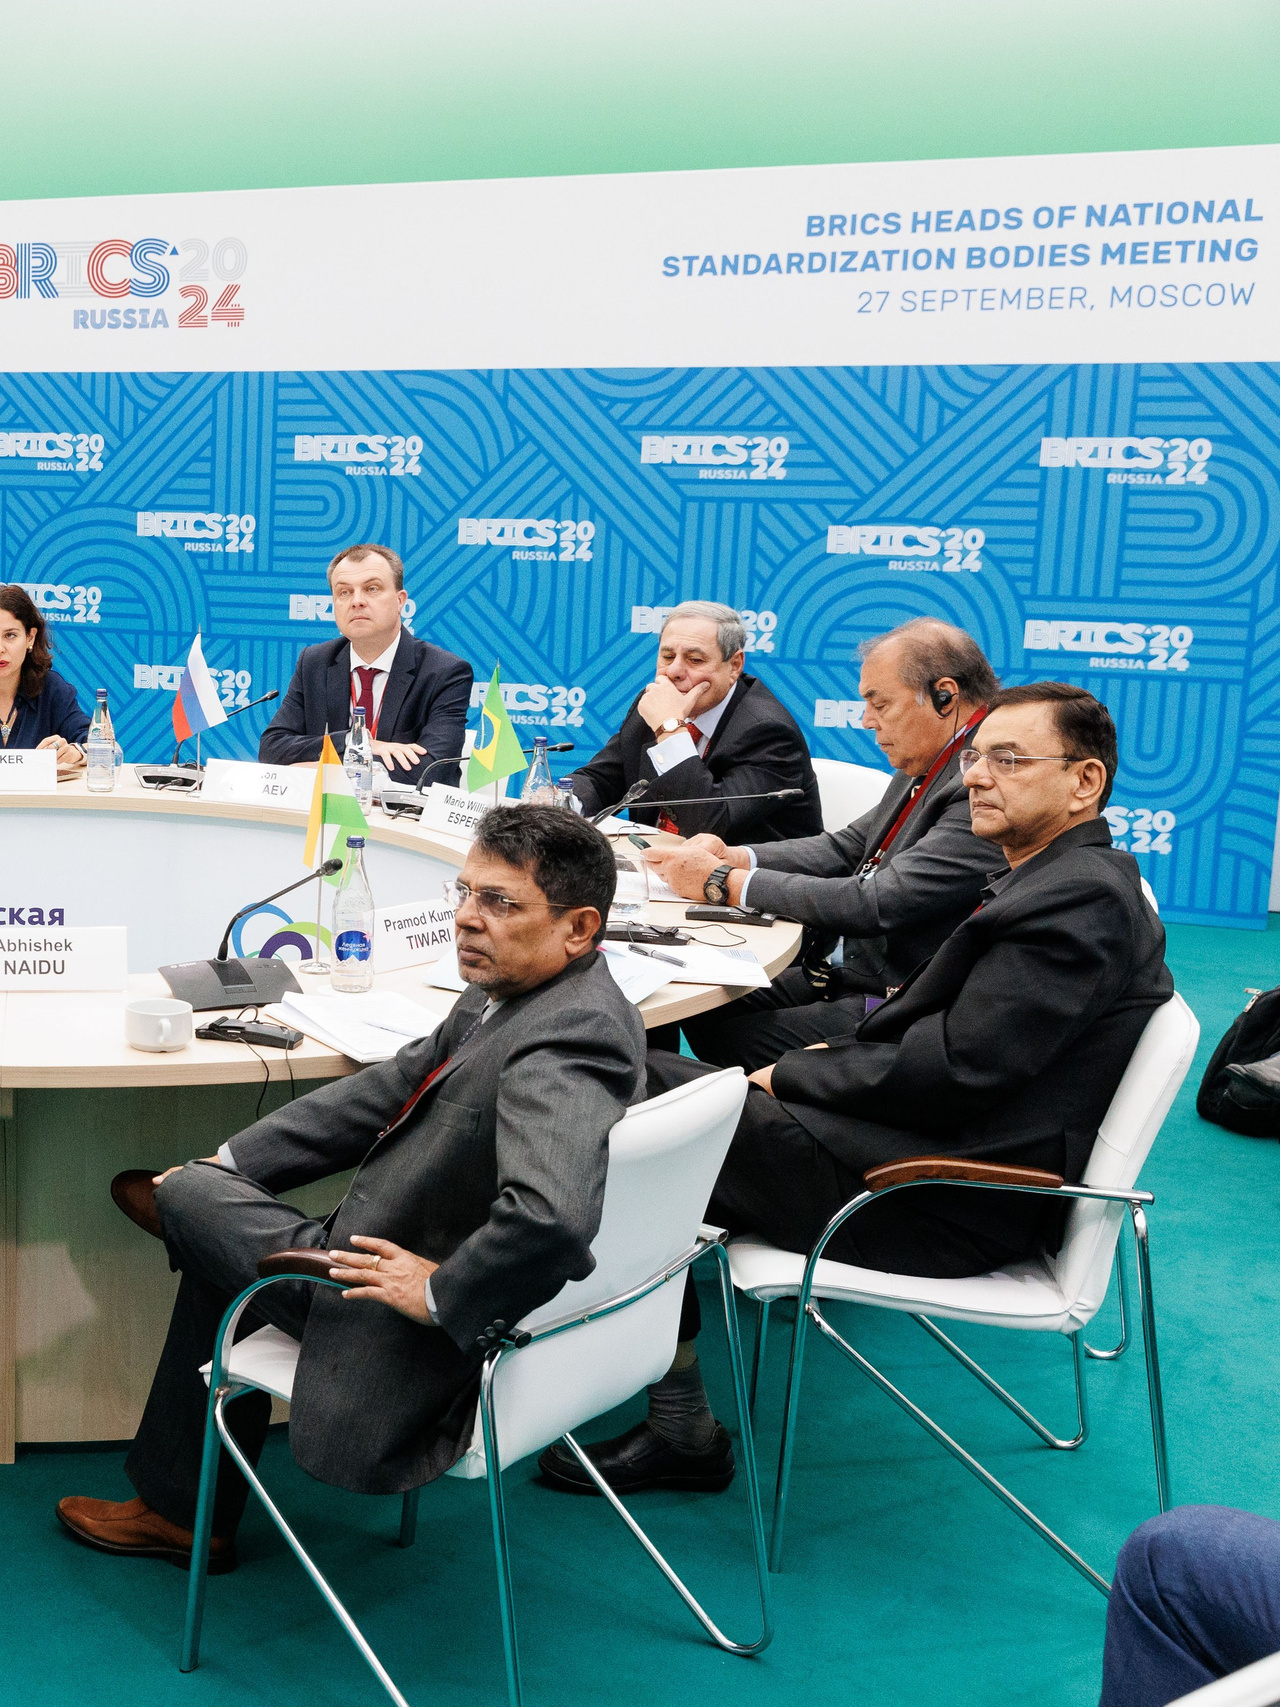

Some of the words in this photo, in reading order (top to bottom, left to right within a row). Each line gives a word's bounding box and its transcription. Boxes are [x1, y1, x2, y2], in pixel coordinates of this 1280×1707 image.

[806, 212, 901, 237] BRICS
[911, 207, 1023, 234] HEADS
[1033, 206, 1076, 229] OF
[1085, 198, 1263, 228] NATIONAL
[662, 248, 956, 277] STANDARDIZATION
[966, 243, 1090, 269] BODIES
[1101, 238, 1258, 266] MEETING
[73, 309, 169, 329] RUSSIA
[178, 284, 245, 329] 24
[857, 291, 890, 313] 27
[901, 287, 1094, 312] SEPTEMBER,
[1110, 282, 1255, 308] MOSCOW
[75, 434, 105, 452] 20
[294, 435, 388, 462] BRICS
[390, 435, 423, 456] 20
[640, 435, 748, 465] BRICS
[751, 436, 790, 459] 20
[1039, 437, 1165, 469] BRICS
[1167, 437, 1212, 462] 20
[37, 462, 74, 471] RUSSIA
[75, 453, 103, 471] 24
[345, 466, 387, 476] RUSSIA
[389, 456, 421, 476] 24
[699, 469, 747, 480] RUSSIA
[749, 458, 787, 480] 24
[1106, 473, 1162, 484] RUSSIA
[1165, 461, 1209, 485] 24
[137, 511, 222, 539] BRICS
[226, 514, 256, 534] 20
[458, 518, 557, 547] BRICS
[559, 520, 596, 541] 20
[184, 542, 223, 552] RUSSIA
[225, 533, 255, 553] 24
[512, 550, 557, 561] RUSSIA
[558, 541, 593, 562] 24
[826, 525, 941, 557] BRICS
[943, 527, 986, 551] 20
[888, 560, 940, 572] RUSSIA
[942, 550, 983, 572] 24
[74, 586, 102, 605] 20
[41, 612, 72, 622] USSIA
[73, 605, 101, 623] 24
[1023, 619, 1146, 654] BRICS
[1149, 624, 1194, 649] 20
[1089, 657, 1145, 670] RUSSIA
[1147, 648, 1190, 671] 24
[221, 669, 251, 689] 20
[551, 686, 586, 708] 20
[550, 706, 584, 727] 24
[444, 794, 466, 809] Mario
[1132, 808, 1176, 833] 20
[1131, 830, 1172, 855] 24
[384, 912, 427, 932] Pramod
[406, 928, 452, 950] TIWARI
[3, 959, 66, 975] NAIDU
